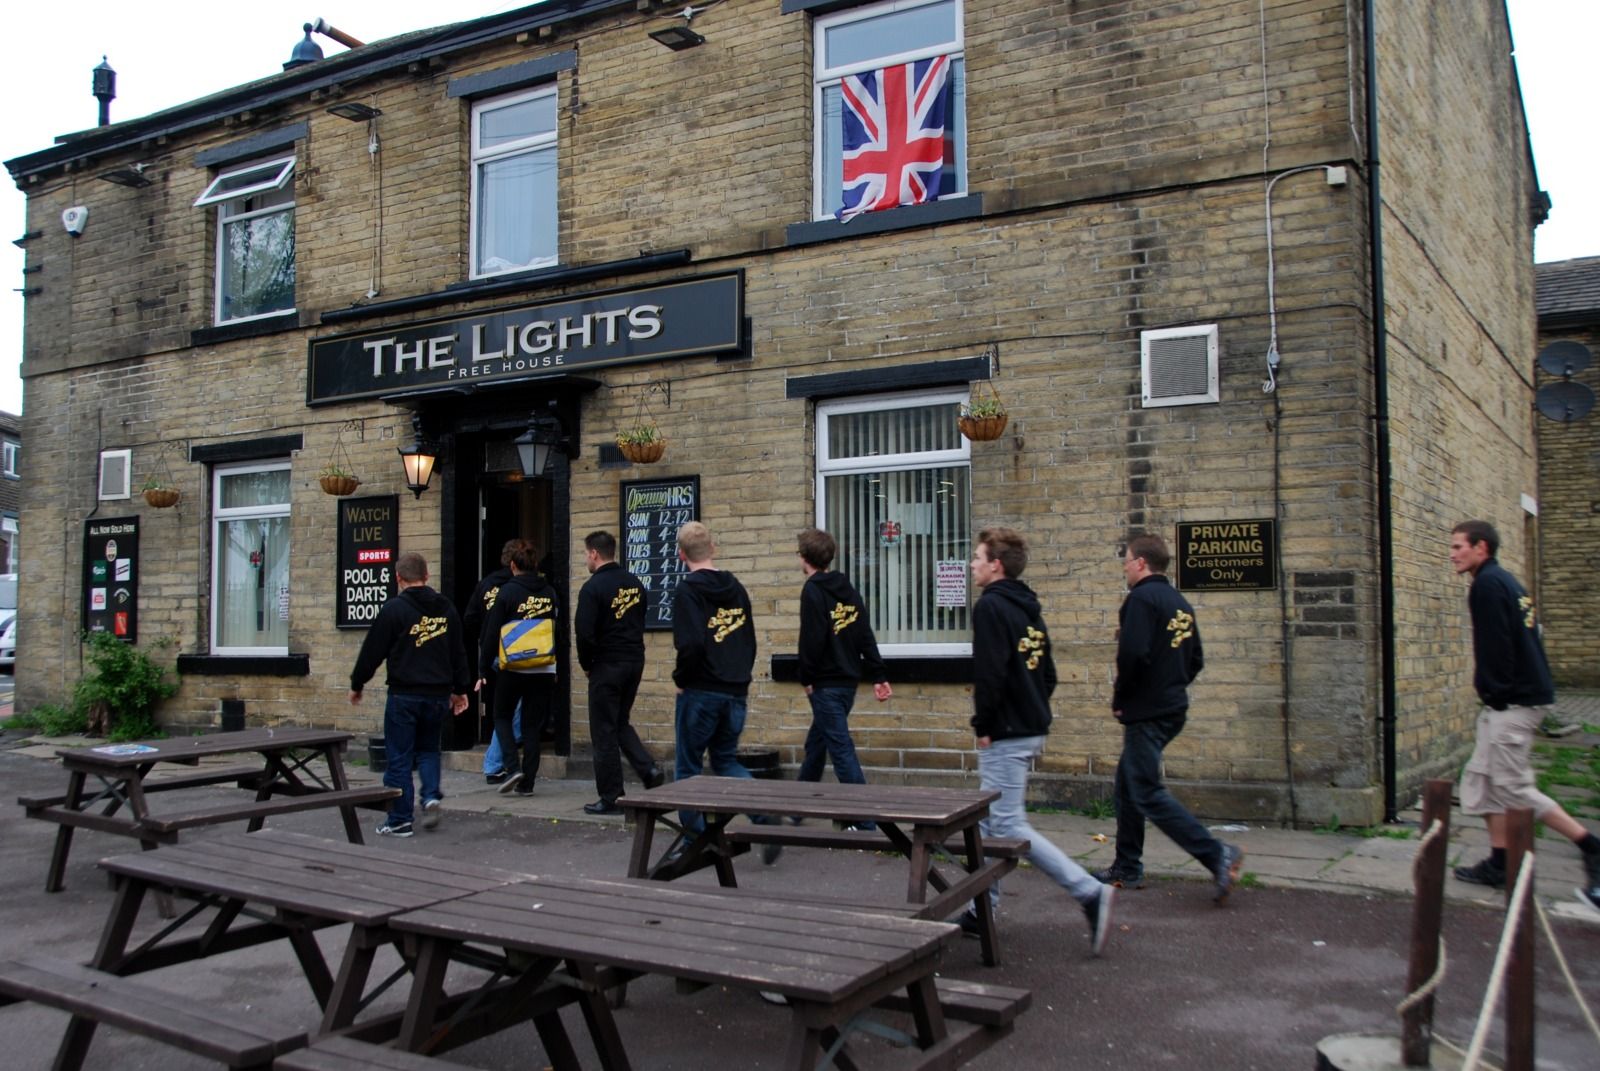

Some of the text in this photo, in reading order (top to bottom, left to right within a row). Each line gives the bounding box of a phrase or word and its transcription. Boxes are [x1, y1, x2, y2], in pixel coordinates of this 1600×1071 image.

[472, 305, 664, 362] LIGHTS
[448, 354, 565, 379] FREE HOUSE
[667, 486, 692, 507] HRS
[347, 507, 390, 524] WATCH
[628, 512, 650, 527] SUN
[353, 527, 383, 542] LIVE
[628, 528, 649, 543] MON
[1191, 524, 1260, 539] PRIVATE
[628, 543, 651, 558] TUES
[1188, 540, 1263, 554] PARKING
[359, 551, 390, 560] SPORTS
[1186, 556, 1264, 568] Customers
[628, 560, 650, 574] WED
[1210, 568, 1244, 581] Only
[344, 568, 390, 584] POOL &
[346, 586, 388, 603] DARTS
